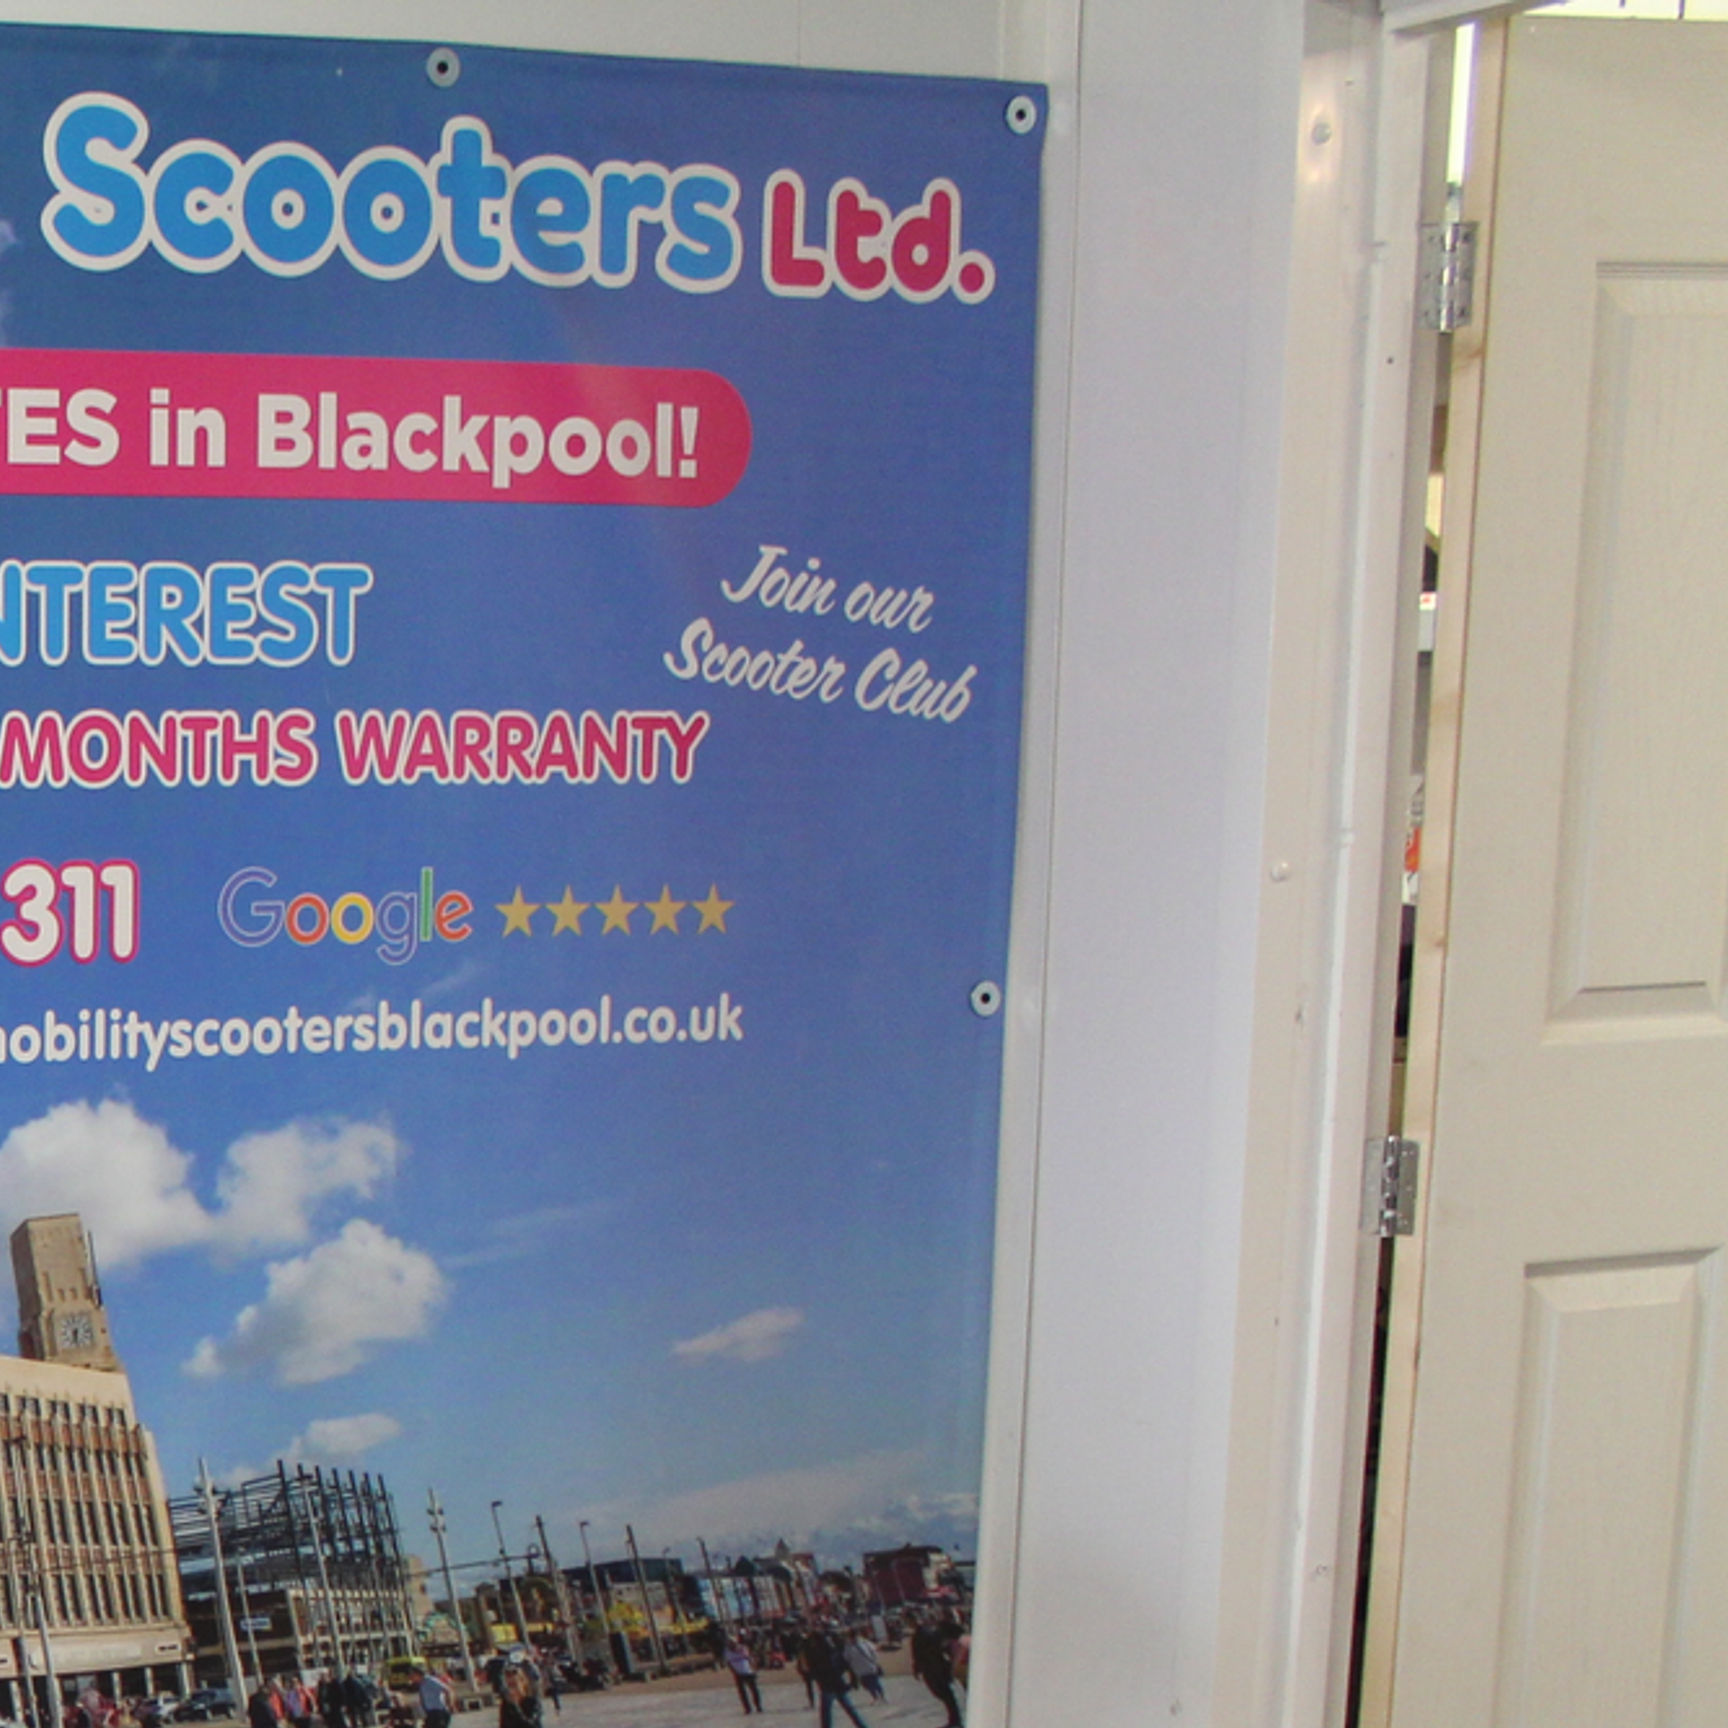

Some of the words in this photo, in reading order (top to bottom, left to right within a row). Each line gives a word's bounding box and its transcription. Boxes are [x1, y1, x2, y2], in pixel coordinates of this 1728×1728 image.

[41, 92, 742, 293] Scooters
[762, 169, 994, 303] Ltd.
[149, 388, 225, 467] in
[257, 392, 698, 489] Blackpool!
[721, 544, 836, 615] Join
[844, 581, 934, 633] our
[663, 617, 845, 703] Scooter
[855, 648, 977, 723] Club
[336, 708, 710, 786] WARRANTY
[217, 865, 473, 967] Google
